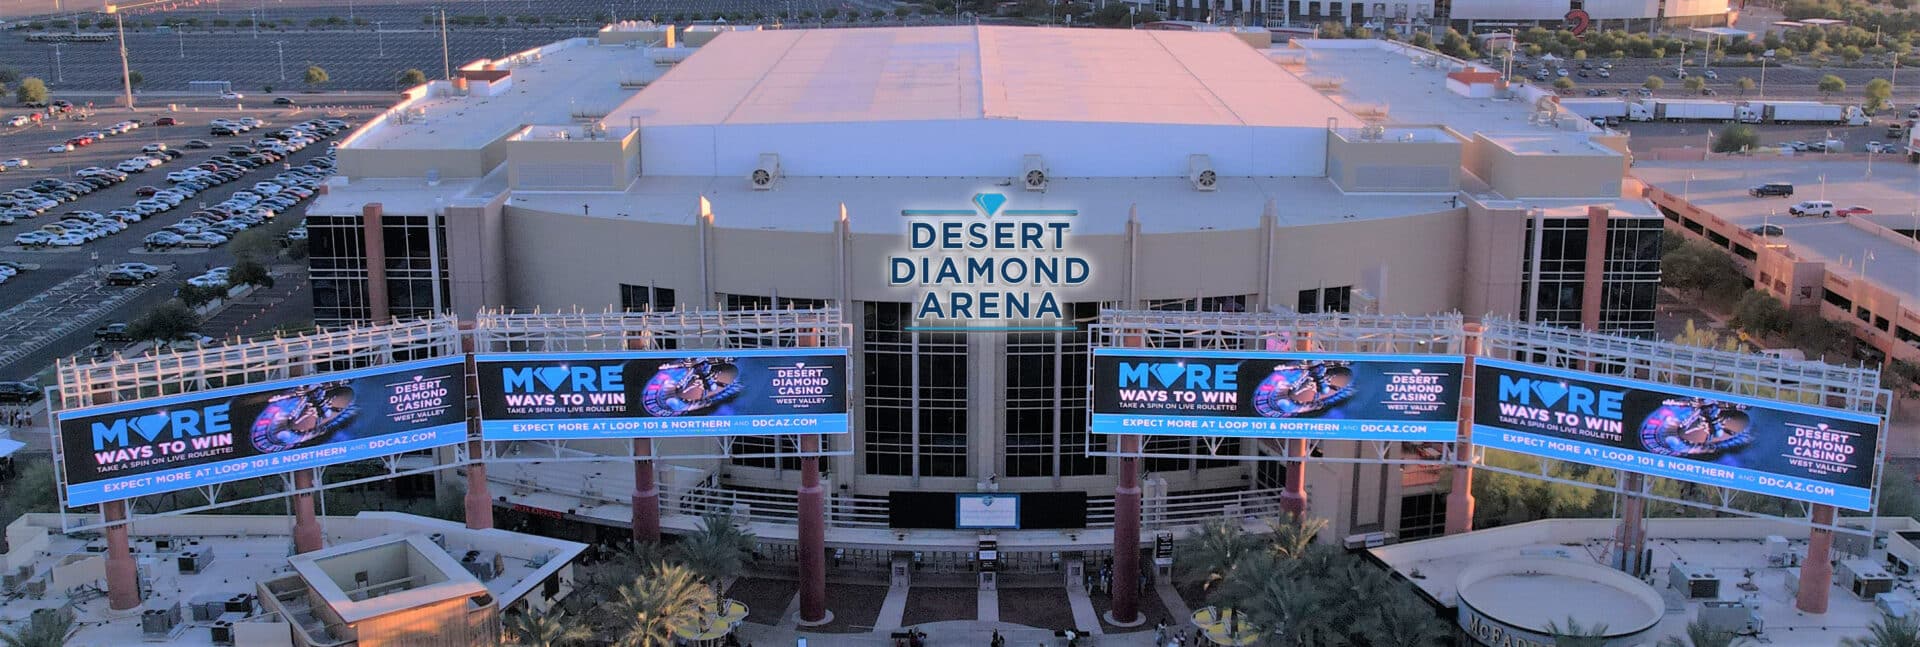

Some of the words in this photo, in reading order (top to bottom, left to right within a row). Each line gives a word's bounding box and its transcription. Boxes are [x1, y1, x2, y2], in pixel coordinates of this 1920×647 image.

[778, 369, 823, 378] DESERT
[1392, 376, 1439, 385] DESERT
[395, 380, 442, 394] DESERT
[772, 378, 829, 387] DIAMOND
[1386, 384, 1443, 393] DIAMOND
[389, 388, 448, 404] DIAMOND
[778, 386, 823, 395] CASINO
[1119, 390, 1168, 401] WAYS
[1173, 391, 1196, 402] TO
[1202, 392, 1237, 403] WIN
[1391, 393, 1437, 401] CASINO
[396, 398, 442, 412] CASINO
[506, 394, 555, 407] WAYS
[560, 393, 584, 405] TO
[589, 393, 626, 404] WIN
[394, 413, 417, 422] WEST
[417, 409, 446, 419] VALLEY
[1499, 403, 1549, 422] WAYS
[1555, 412, 1579, 426] TO
[1585, 417, 1623, 434] WIN
[513, 423, 554, 432] EXPECT
[558, 423, 589, 431] MORE
[592, 423, 606, 431] AT
[610, 422, 639, 430] LOOP
[643, 421, 659, 429] 101
[661, 421, 668, 429] &
[671, 420, 731, 429] NORTHERN
[752, 419, 817, 427] DDCAZ.COM
[1123, 419, 1163, 427] EXPECT
[1167, 420, 1198, 428] MORE
[1219, 421, 1248, 429] LOOP
[1251, 422, 1267, 430] 101
[1270, 422, 1276, 430] &
[1280, 423, 1339, 431] NORTHERN
[1361, 424, 1427, 433] DDCAZ.COM
[1500, 416, 1519, 425] TAKE
[1527, 420, 1545, 428] SPIN
[1546, 423, 1558, 431] ON
[1560, 425, 1577, 434] LIVE
[1579, 428, 1622, 441] ROULETTE!
[1795, 428, 1849, 444] DESERT
[94, 445, 153, 465] WAYS
[159, 440, 186, 458] TO
[191, 433, 233, 450] WIN
[1788, 436, 1855, 455] DIAMOND
[97, 464, 119, 473] TAKE
[130, 459, 150, 468] SPIN
[151, 457, 165, 465] ON
[167, 453, 186, 462] LIVE
[188, 447, 233, 459] ROULETTE!
[1793, 447, 1847, 463] CASINO
[104, 477, 151, 493] EXPECT
[155, 471, 192, 484] MORE
[195, 468, 212, 478] AT
[215, 462, 249, 475] LOOP
[251, 455, 269, 468] 101
[272, 456, 279, 465] &
[282, 447, 347, 463] NORTHERN
[369, 432, 437, 449] DDCAZ.COM
[1503, 434, 1545, 448] EXPECT
[1548, 441, 1581, 454] MORE
[1584, 446, 1599, 456] AT
[1603, 449, 1634, 462] LOOP
[1637, 455, 1654, 466] 101
[1657, 459, 1665, 468] &
[1668, 461, 1735, 479] NORTHERN
[1738, 474, 1755, 482] AND
[1759, 476, 1835, 496] DDCAZ.COM
[1789, 459, 1813, 469] WEST
[1815, 463, 1848, 474] VALLEY
